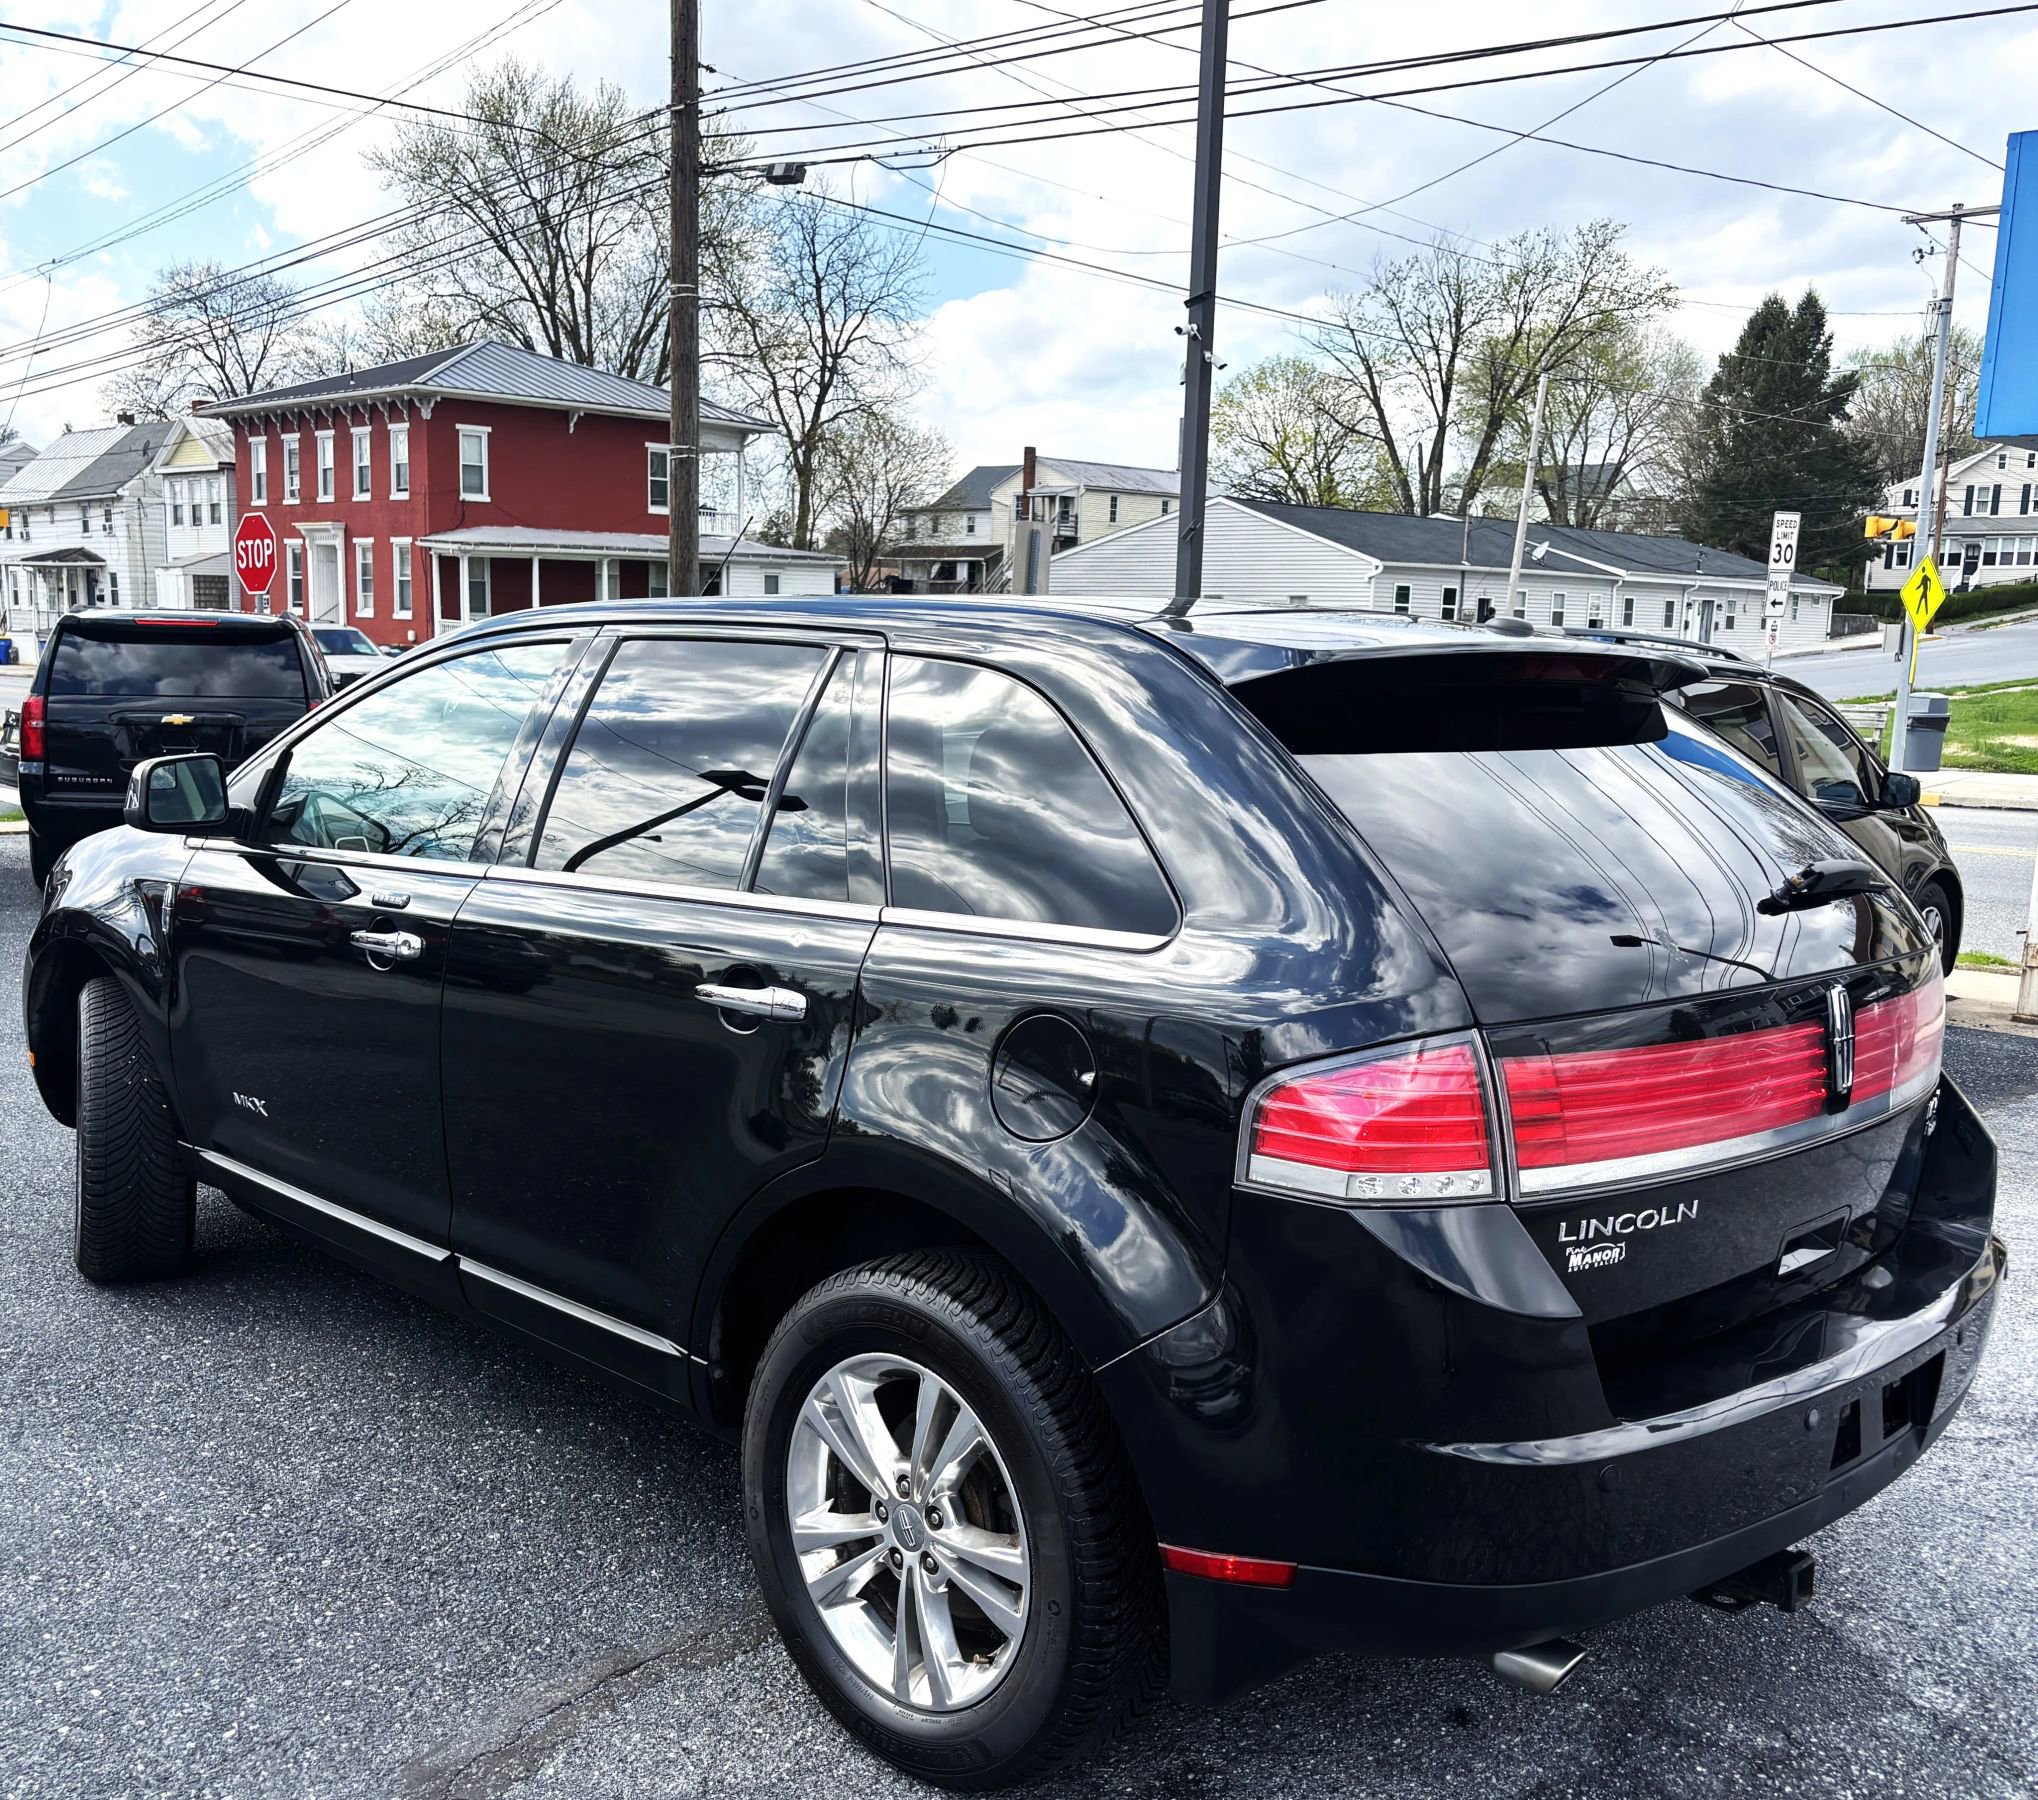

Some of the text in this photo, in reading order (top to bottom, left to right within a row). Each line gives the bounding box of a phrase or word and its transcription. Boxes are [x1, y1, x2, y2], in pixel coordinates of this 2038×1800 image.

[1776, 519, 1797, 529] SPEED
[1776, 531, 1794, 540] LIMIT
[238, 538, 273, 569] STOP
[1773, 543, 1793, 564] 30
[1769, 580, 1788, 591] POLICE
[57, 776, 113, 784] SUBURBAN
[232, 1091, 269, 1117] MKX
[1558, 1199, 1699, 1242] LINCOLN
[1565, 1246, 1587, 1257] Pine
[1568, 1247, 1621, 1268] MANOR
